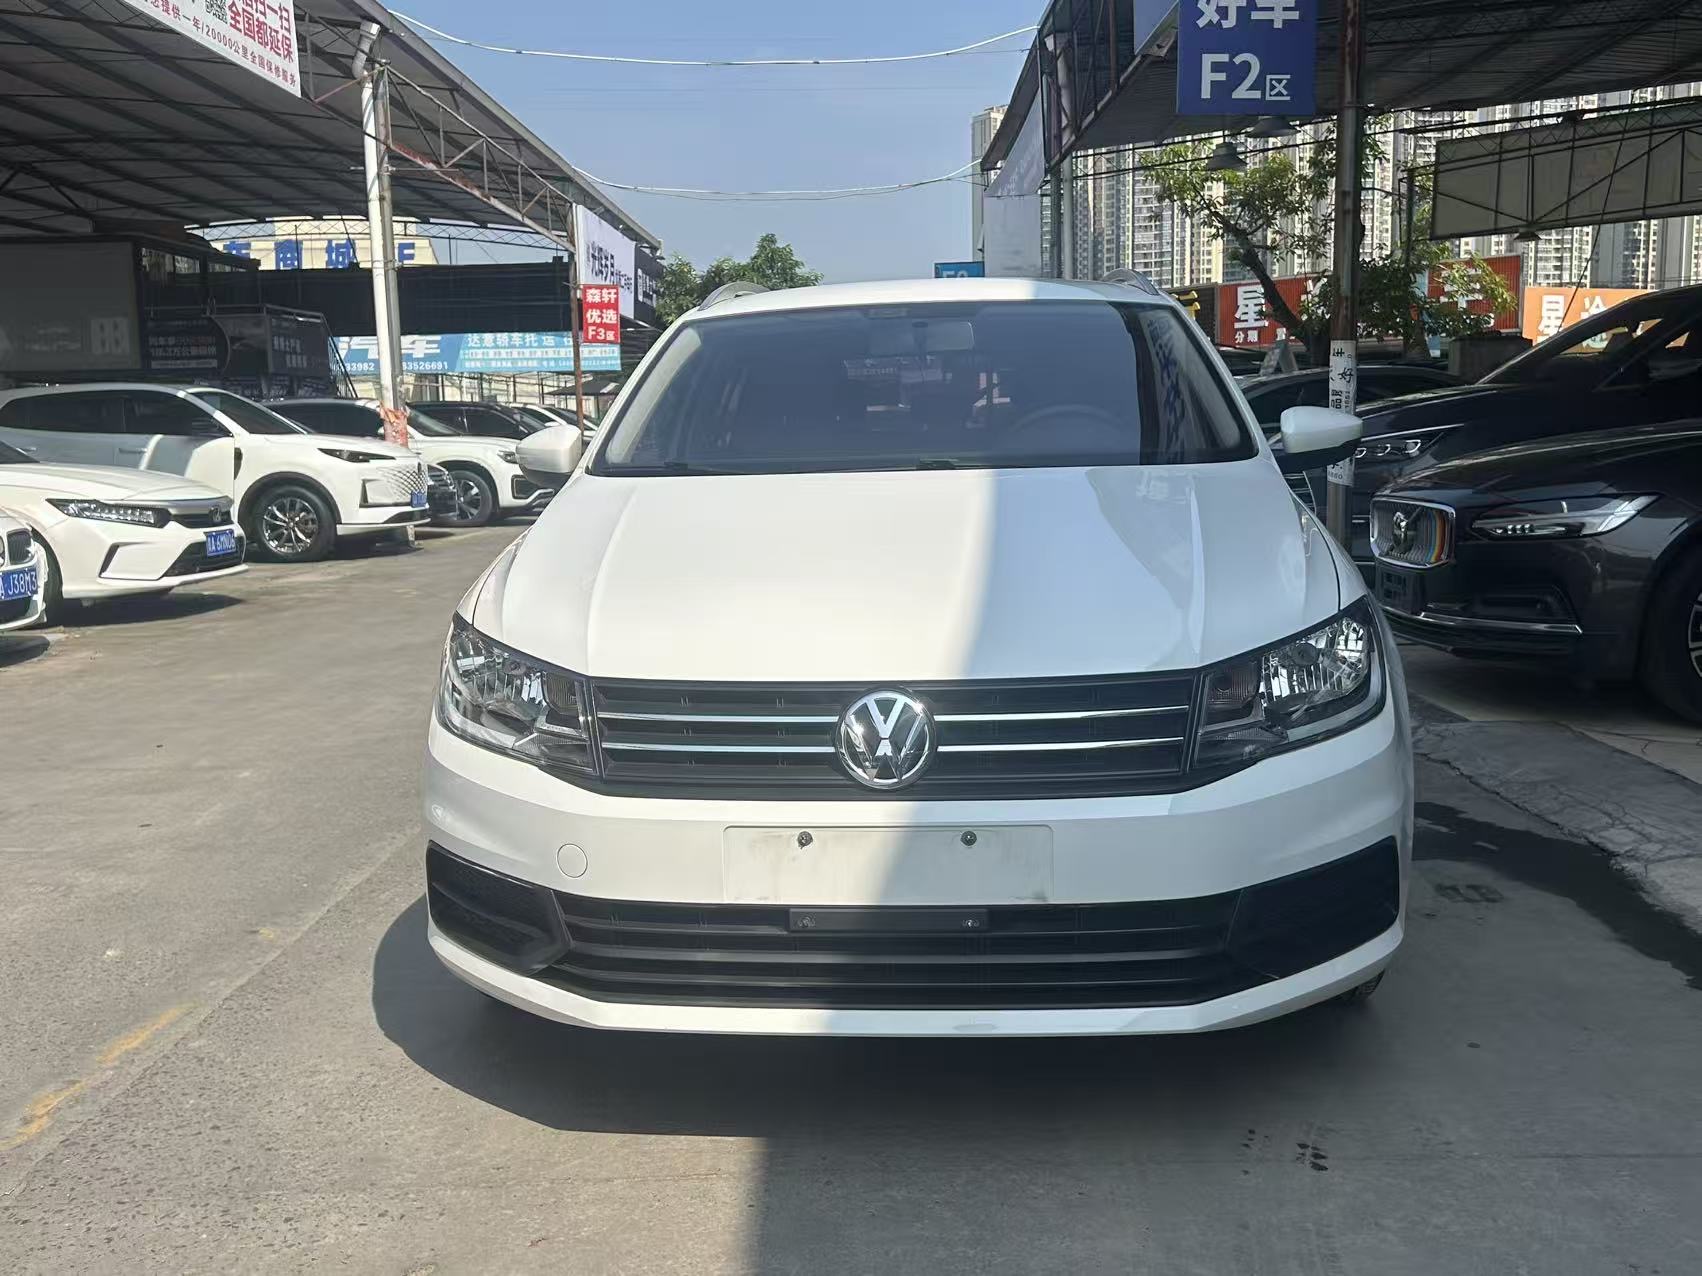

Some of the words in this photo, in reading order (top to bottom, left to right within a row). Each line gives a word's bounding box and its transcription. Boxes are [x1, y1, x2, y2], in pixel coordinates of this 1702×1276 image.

[228, 1, 294, 63] 全国都延保
[1200, 52, 1292, 101] F2区
[586, 288, 617, 304] 森轩
[586, 309, 617, 325] 优选
[587, 327, 616, 341] F3区
